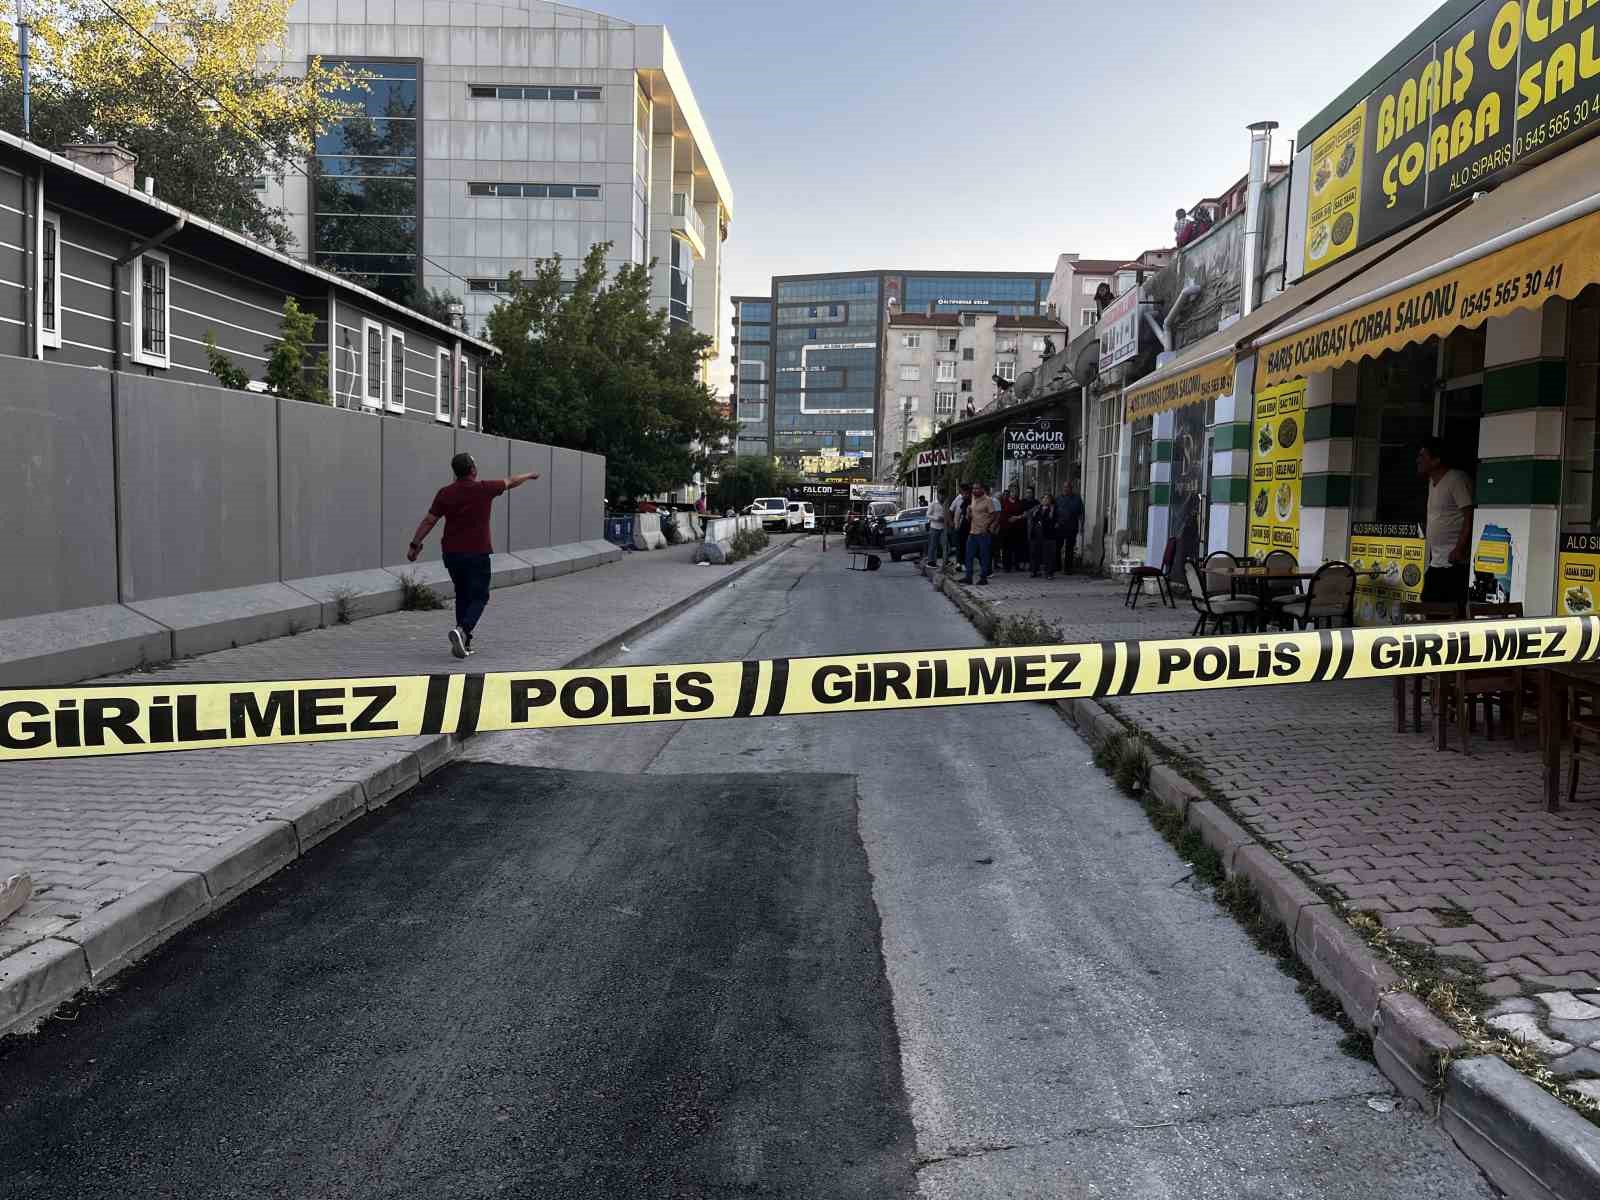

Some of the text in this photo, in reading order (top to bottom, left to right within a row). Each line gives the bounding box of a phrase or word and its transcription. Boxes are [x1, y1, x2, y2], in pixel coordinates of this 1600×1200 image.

[1376, 30, 1475, 153] BARIŞ
[1382, 91, 1501, 208] ÇORBA
[1449, 167, 1470, 192] ALO
[1525, 124, 1546, 151] 545
[1548, 110, 1570, 138] 565
[1573, 100, 1589, 125] 30
[1349, 307, 1391, 352] ÇORBA
[1395, 281, 1458, 333] SALONU
[1460, 288, 1490, 319] 0545
[1494, 277, 1520, 307] 565
[1522, 270, 1541, 297] 30
[1544, 264, 1563, 289] 41
[1010, 428, 1064, 441] YAĞMUR
[1567, 535, 1587, 549] ALO
